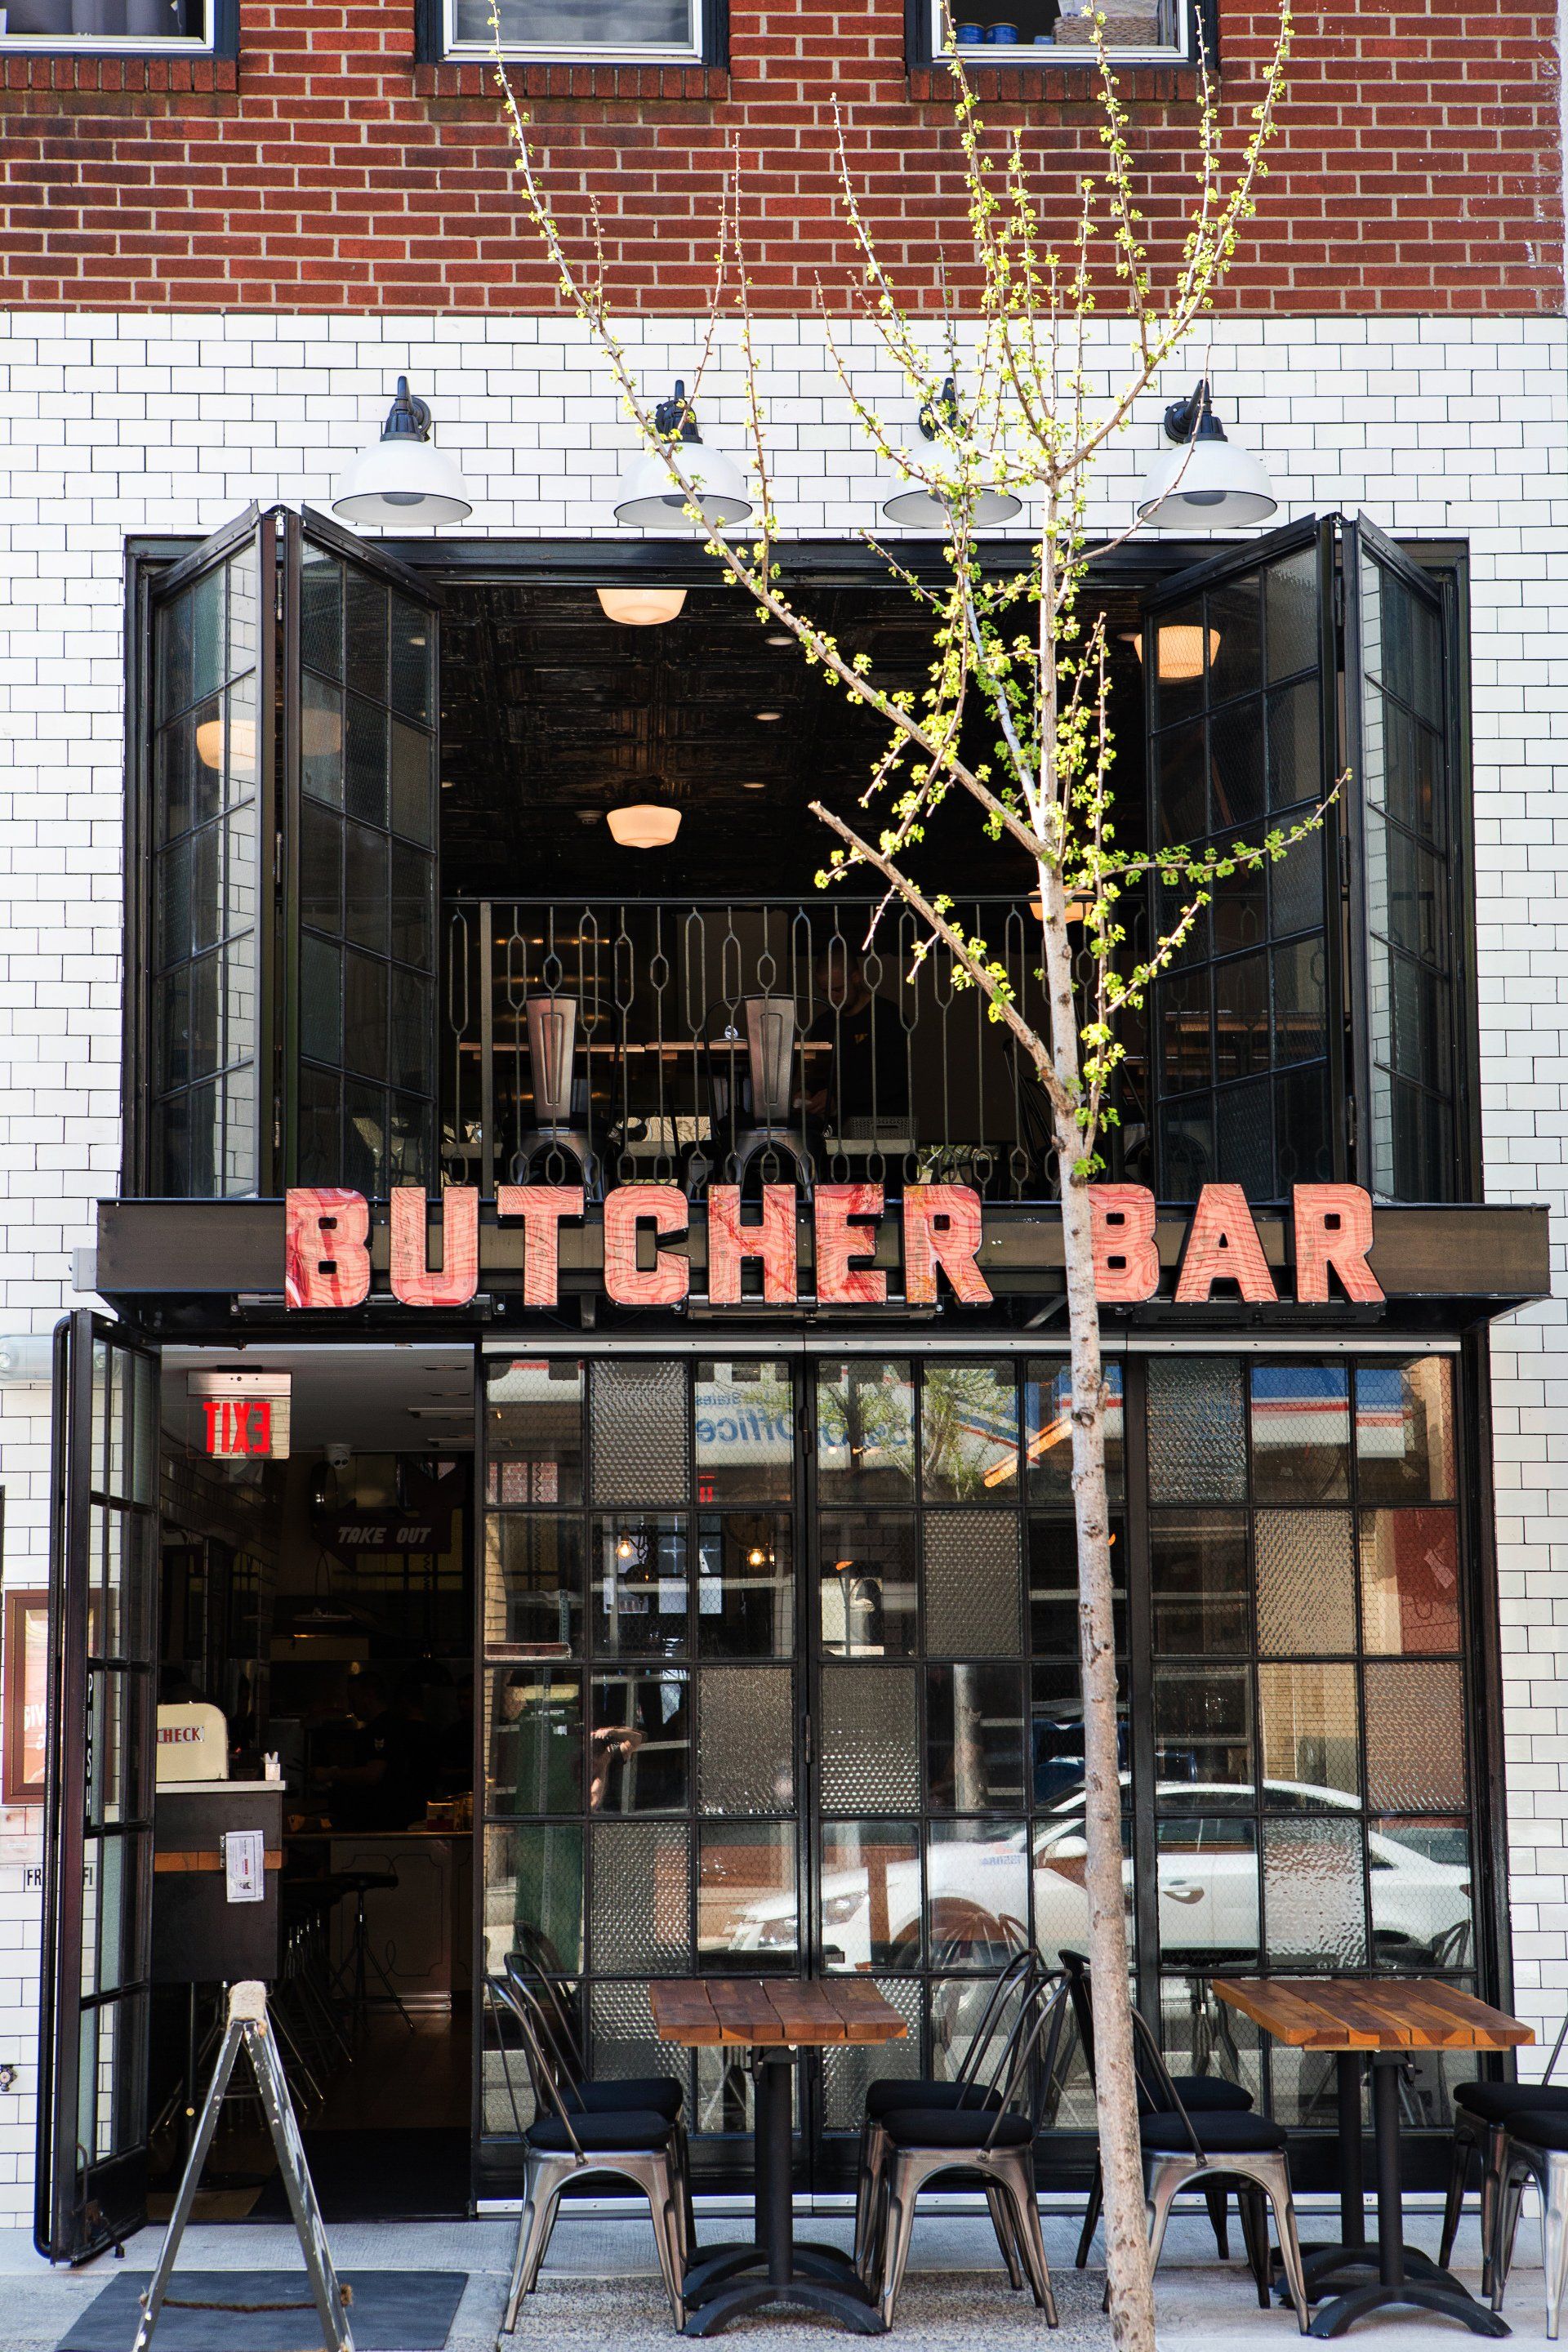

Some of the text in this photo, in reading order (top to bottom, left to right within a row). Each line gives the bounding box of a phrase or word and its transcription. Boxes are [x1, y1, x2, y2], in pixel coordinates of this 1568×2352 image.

[285, 1183, 1387, 1308] BUTCHER BAR
[337, 1526, 432, 1544] TAKE OUT
[86, 1673, 94, 1817] PUSH
[156, 1727, 201, 1744] CHECK
